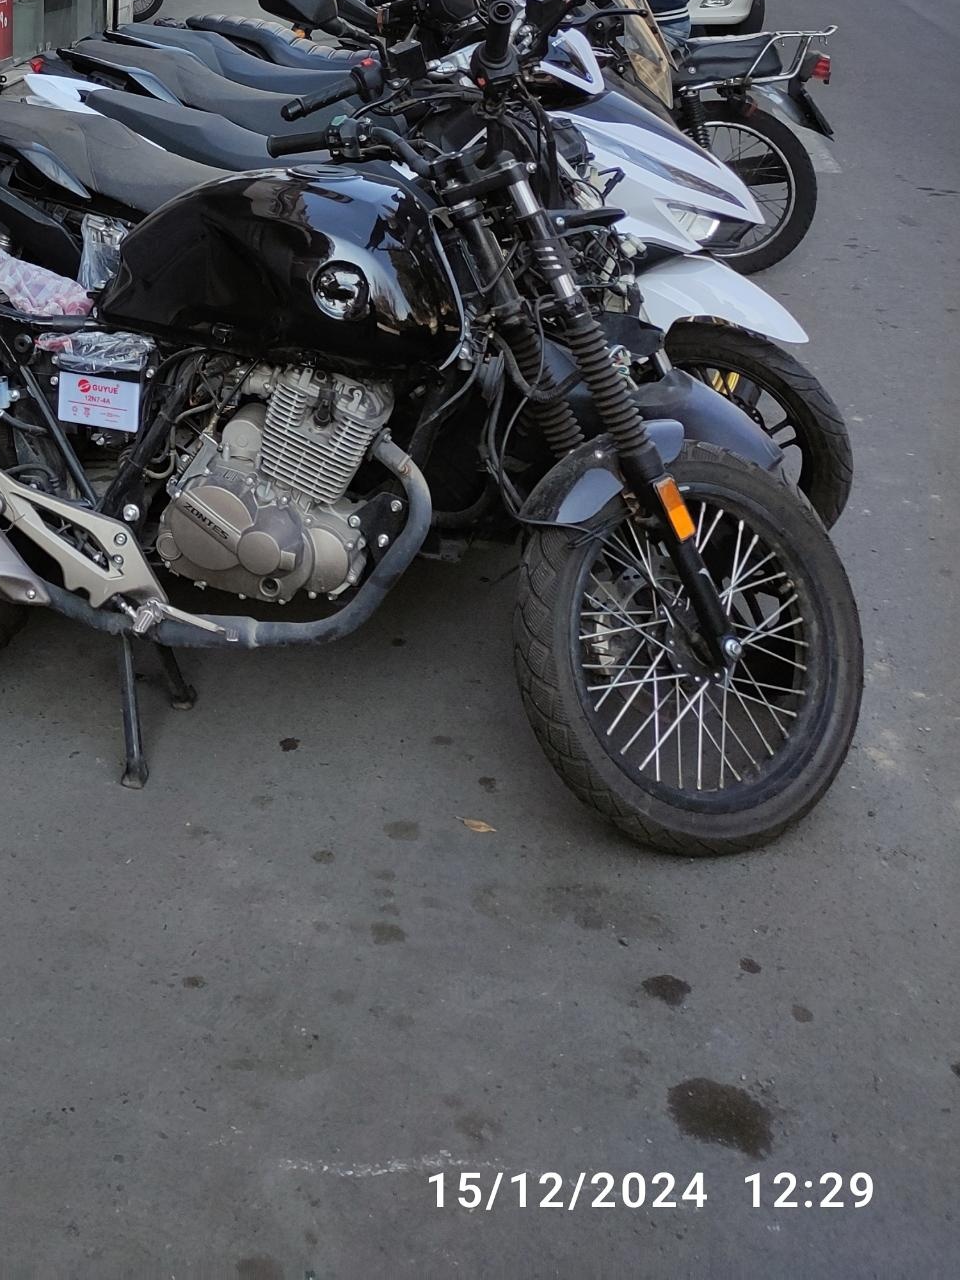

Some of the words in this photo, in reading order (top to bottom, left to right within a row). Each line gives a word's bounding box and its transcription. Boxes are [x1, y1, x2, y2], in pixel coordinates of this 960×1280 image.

[92, 384, 119, 395] GUYUE
[84, 395, 111, 405] 12N7-4A
[183, 501, 230, 540] ZONTES
